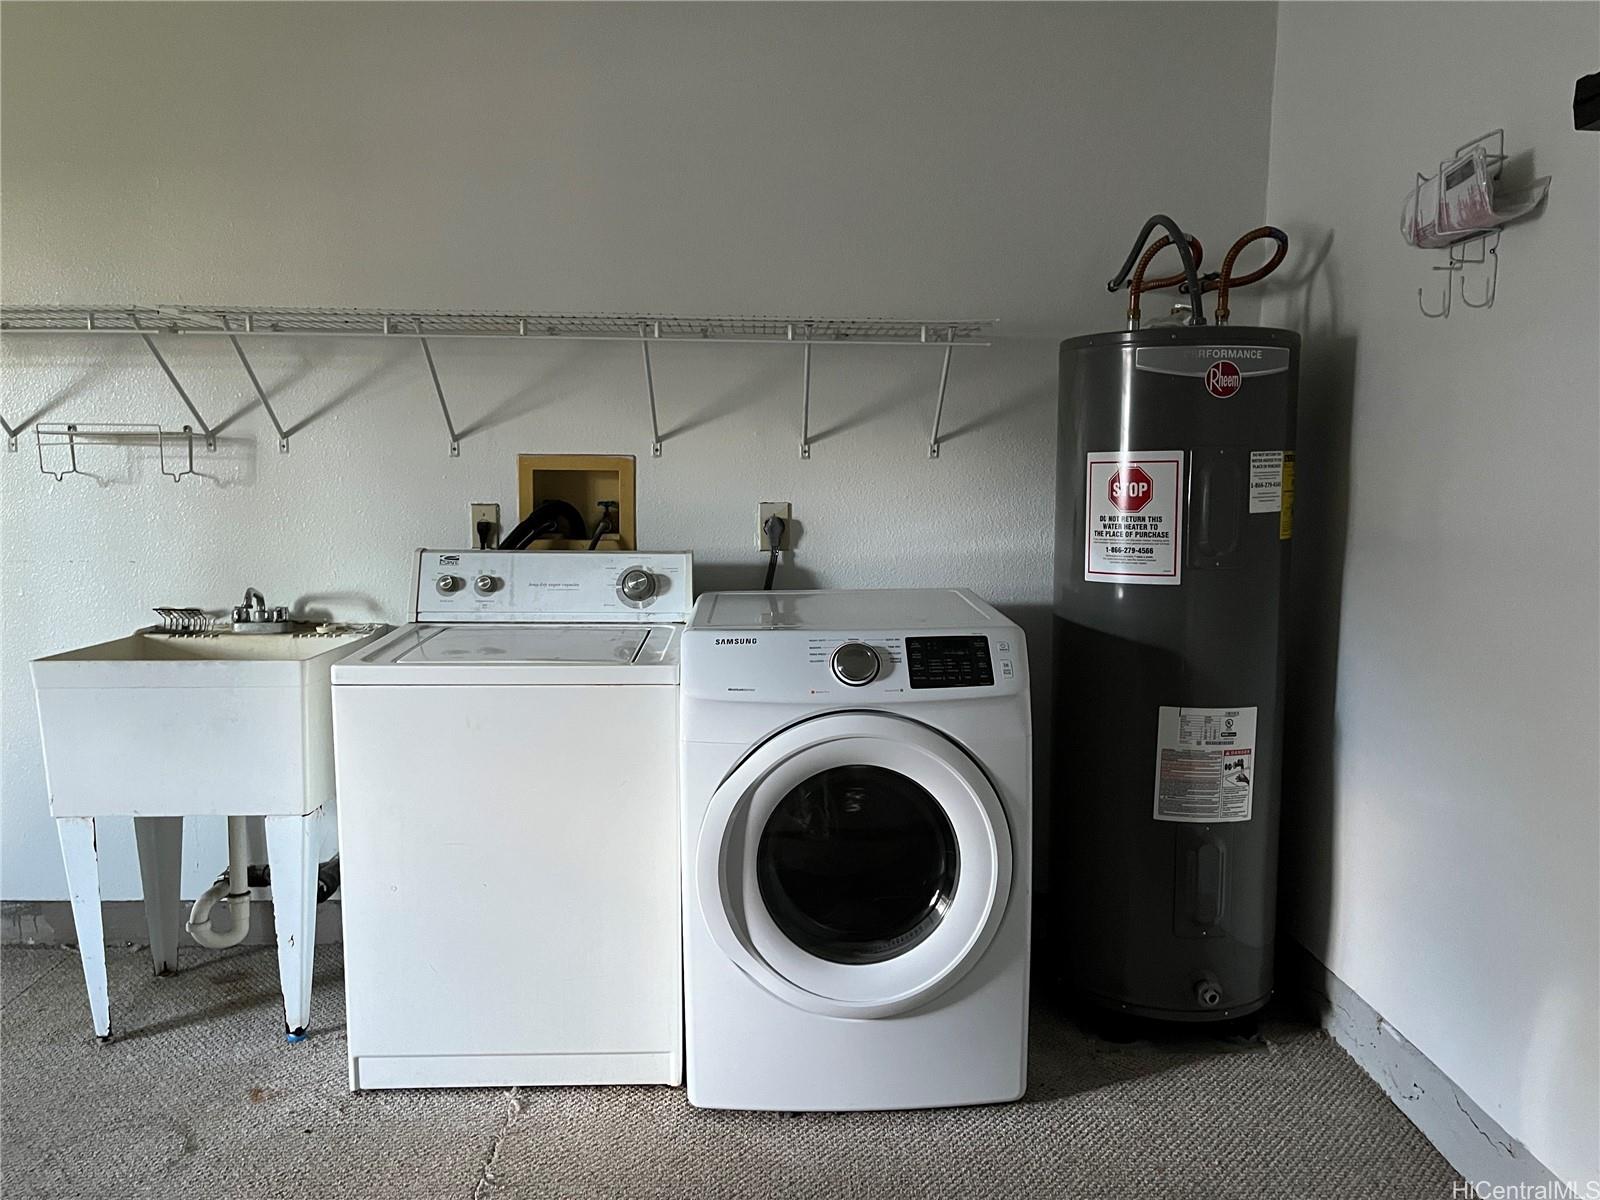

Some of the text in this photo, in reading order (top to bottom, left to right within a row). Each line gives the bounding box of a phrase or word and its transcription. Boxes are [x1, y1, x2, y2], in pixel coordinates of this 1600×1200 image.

[1209, 362, 1239, 392] Rheem
[1112, 482, 1148, 498] STOP
[1135, 531, 1170, 539] PURCHASE
